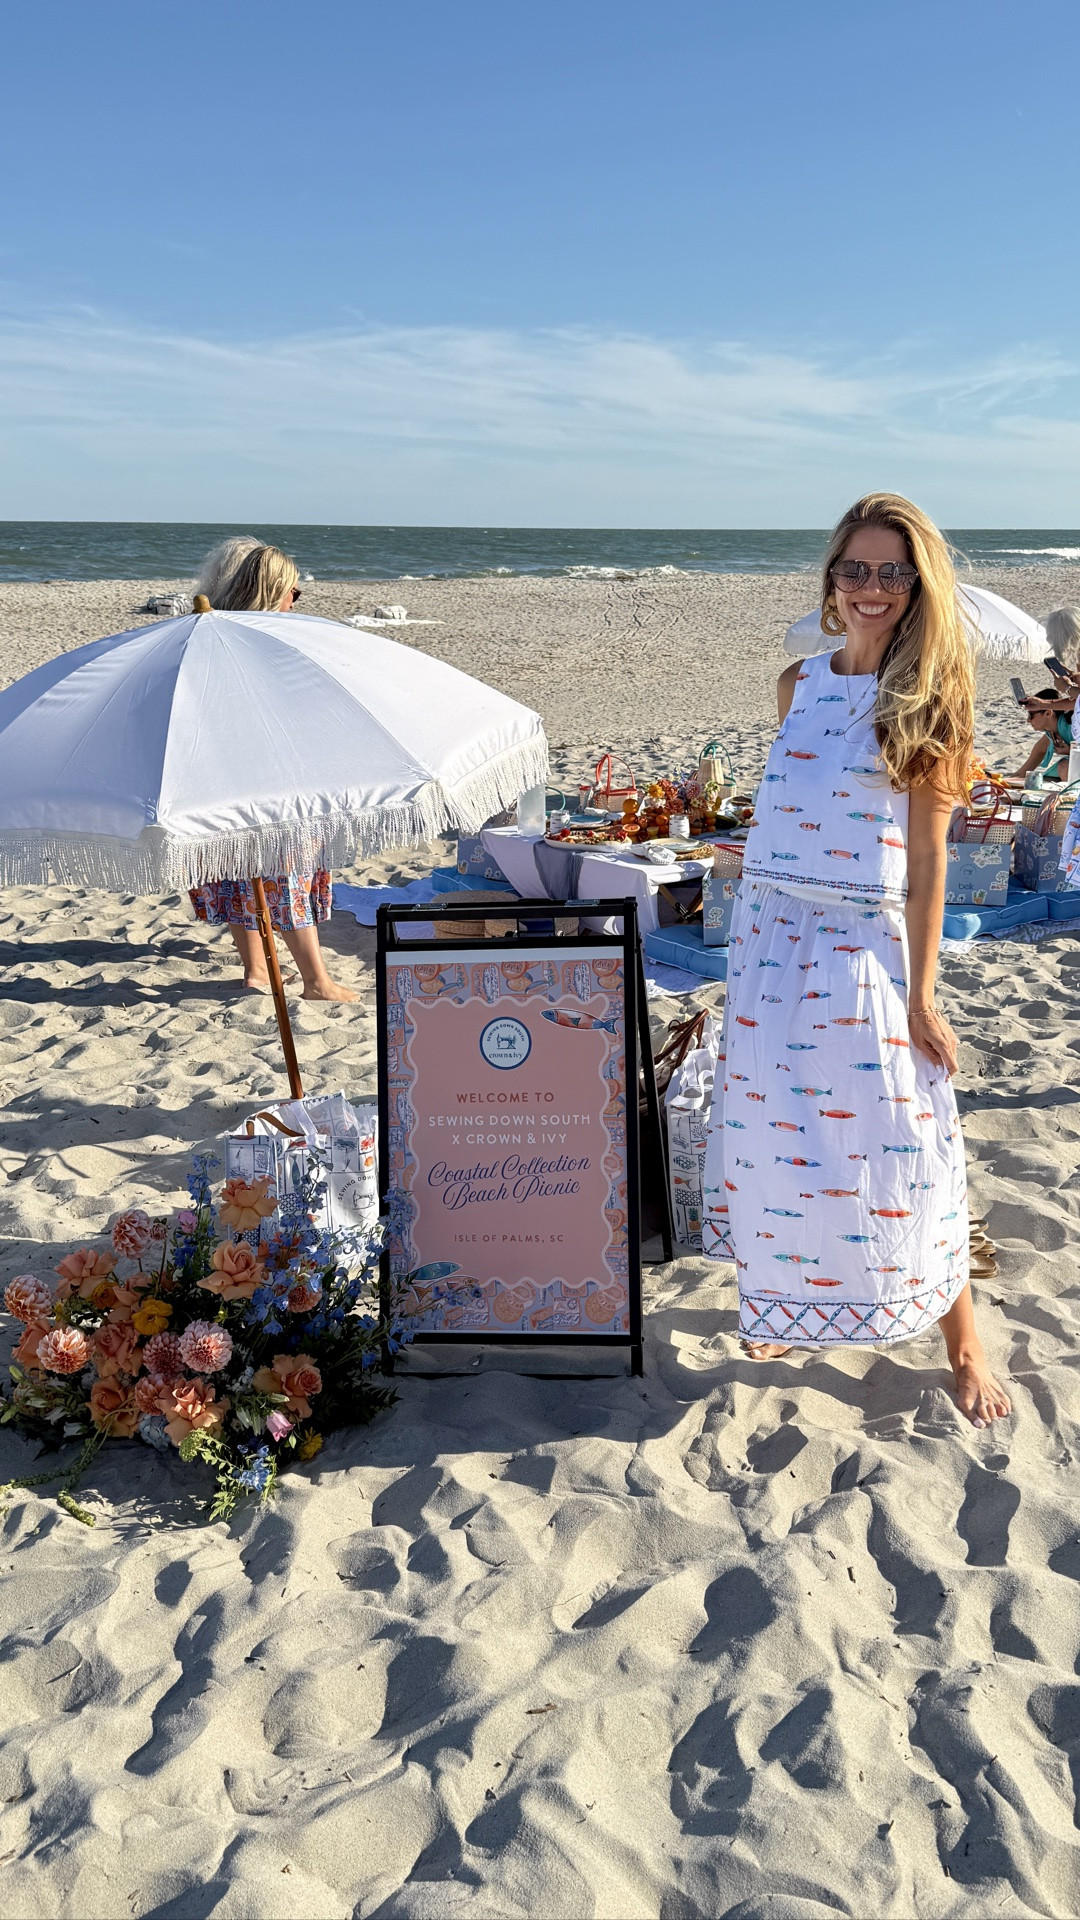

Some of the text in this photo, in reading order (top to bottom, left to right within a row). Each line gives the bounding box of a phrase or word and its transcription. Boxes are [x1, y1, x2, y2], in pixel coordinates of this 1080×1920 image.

[486, 1025, 500, 1042] SEWING
[514, 1026, 525, 1042] SOUTH
[456, 1091, 555, 1103] WELCOME TO
[428, 1114, 591, 1127] SEWING DOWN SOUTH
[452, 1133, 567, 1145] X CROWN & IVY
[427, 1153, 591, 1187] Coastal Collection
[337, 1179, 356, 1201] SEWING
[442, 1174, 581, 1211] Beach Picnic
[454, 1234, 565, 1244] ISLE OF PALMS, SC
